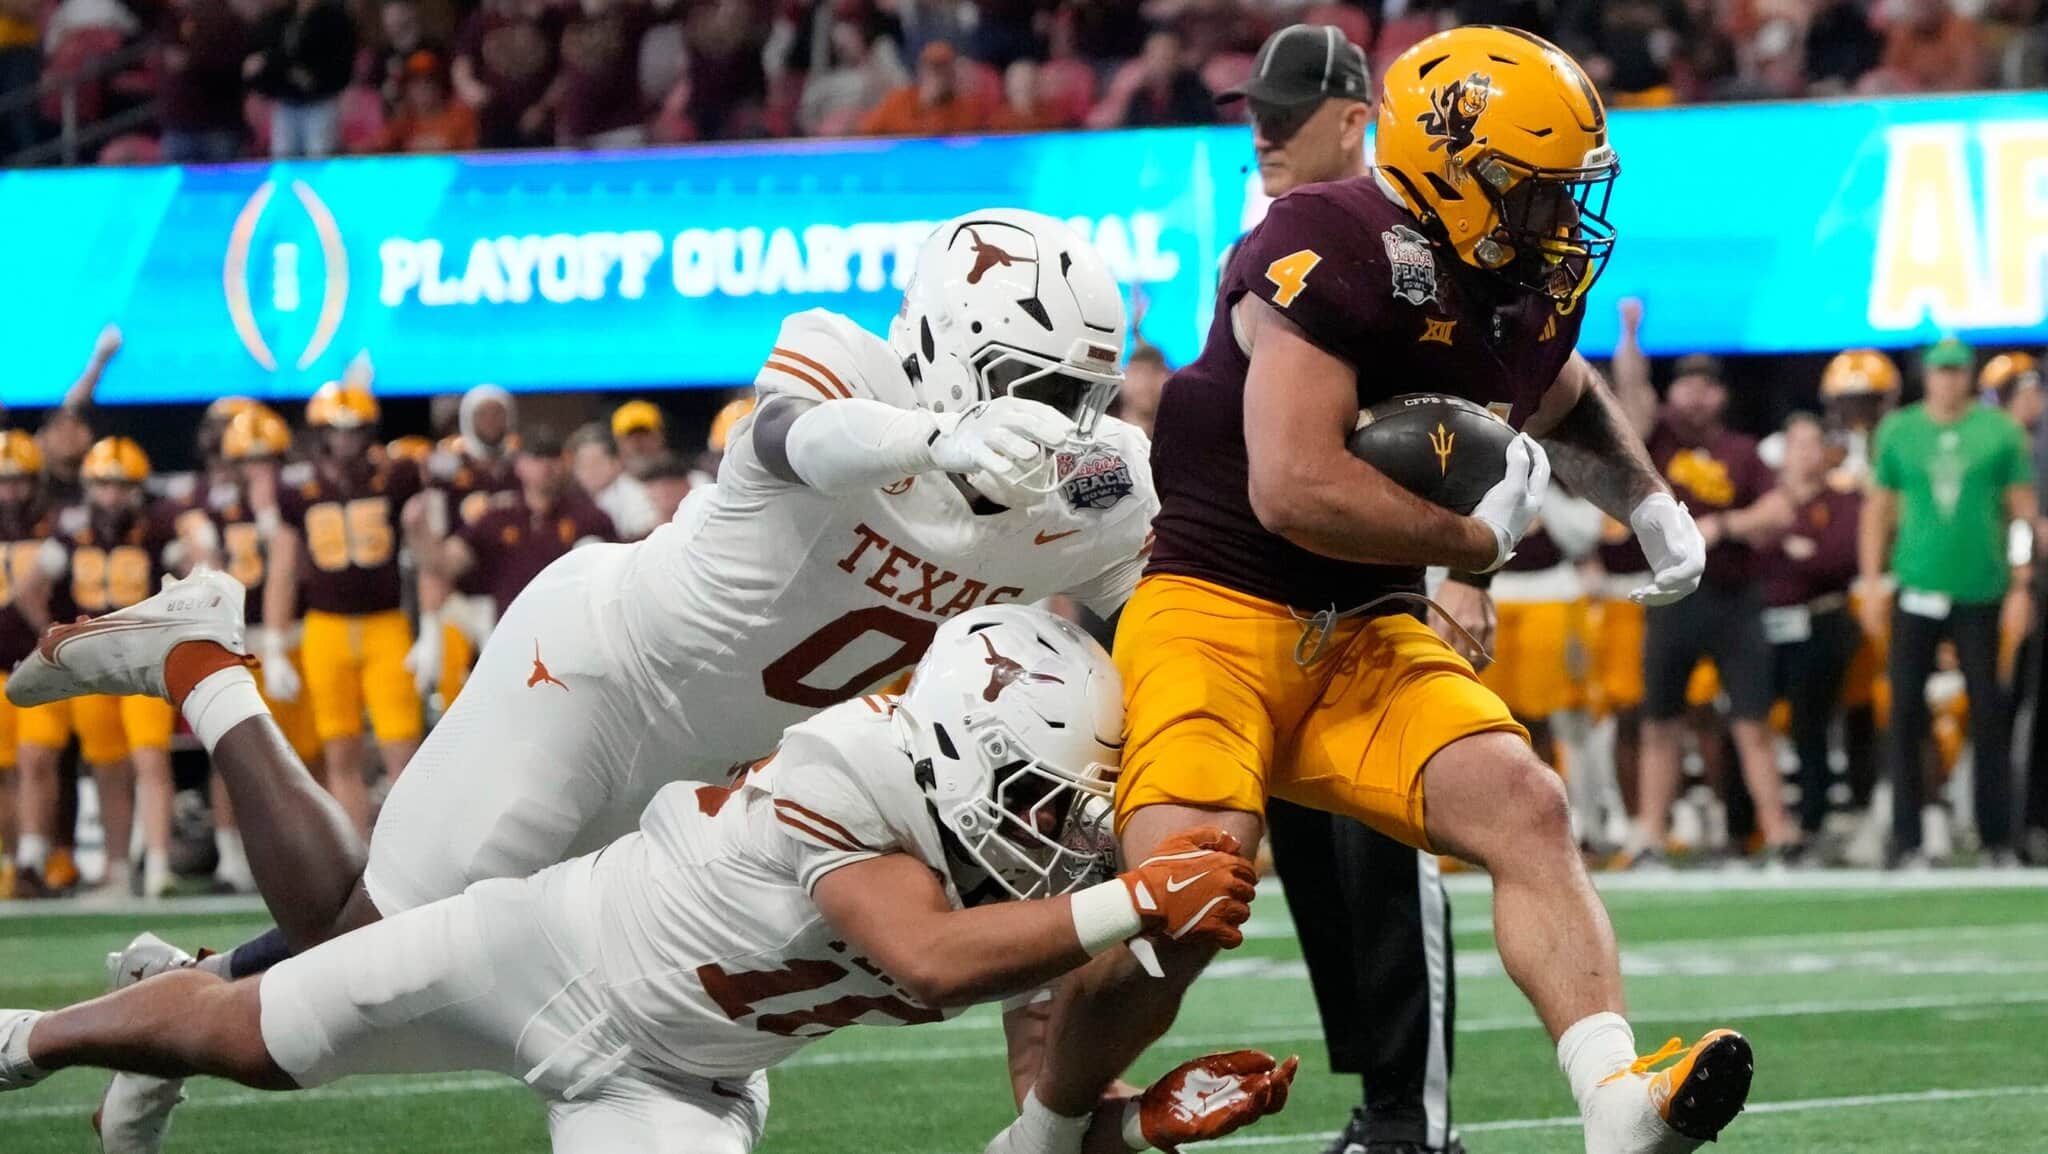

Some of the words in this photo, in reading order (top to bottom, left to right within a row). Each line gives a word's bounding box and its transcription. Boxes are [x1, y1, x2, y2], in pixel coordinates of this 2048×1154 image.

[380, 230, 664, 307] PLAYOFF
[1265, 249, 1323, 308] 4
[1063, 467, 1132, 502] PEACH
[762, 605, 938, 709] 0
